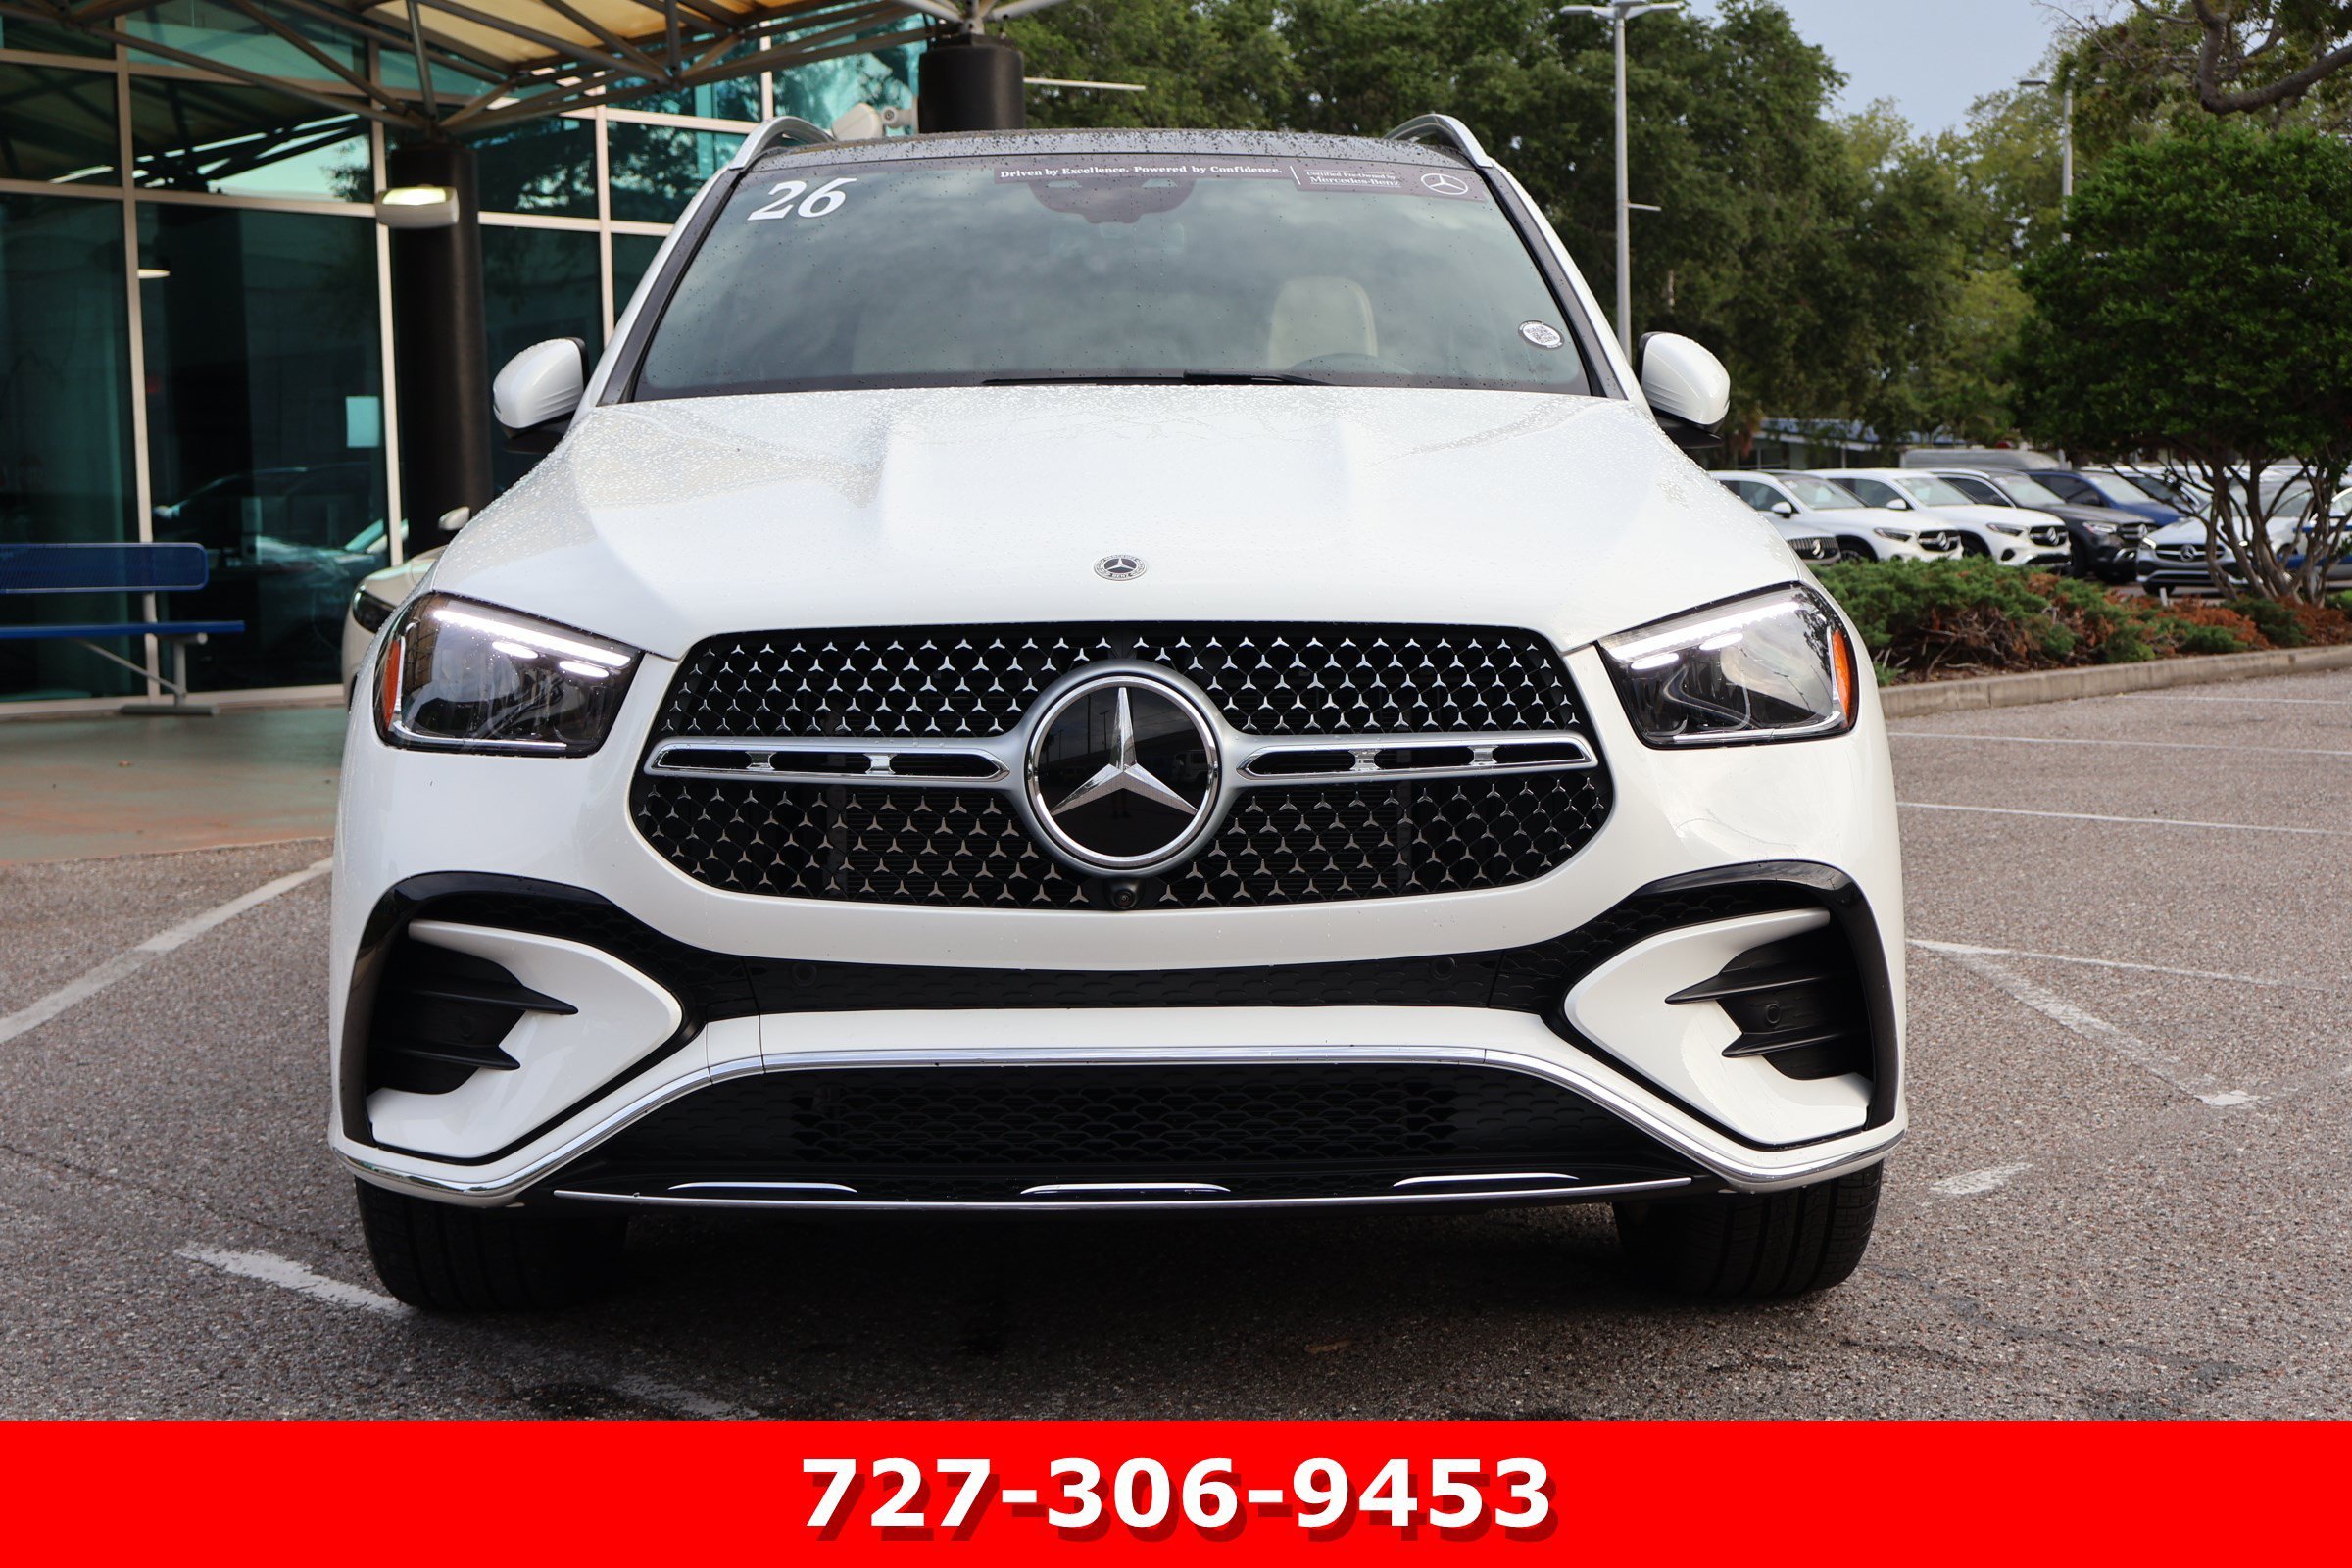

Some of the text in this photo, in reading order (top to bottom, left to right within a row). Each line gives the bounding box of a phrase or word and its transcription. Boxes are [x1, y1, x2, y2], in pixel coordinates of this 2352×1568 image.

[1000, 170, 1043, 178] Driven
[1045, 168, 1058, 176] by
[1061, 166, 1129, 175] Excellence.
[1191, 165, 1207, 174] by
[1309, 176, 1400, 187] Mercedes-Benz
[747, 177, 858, 220] 26
